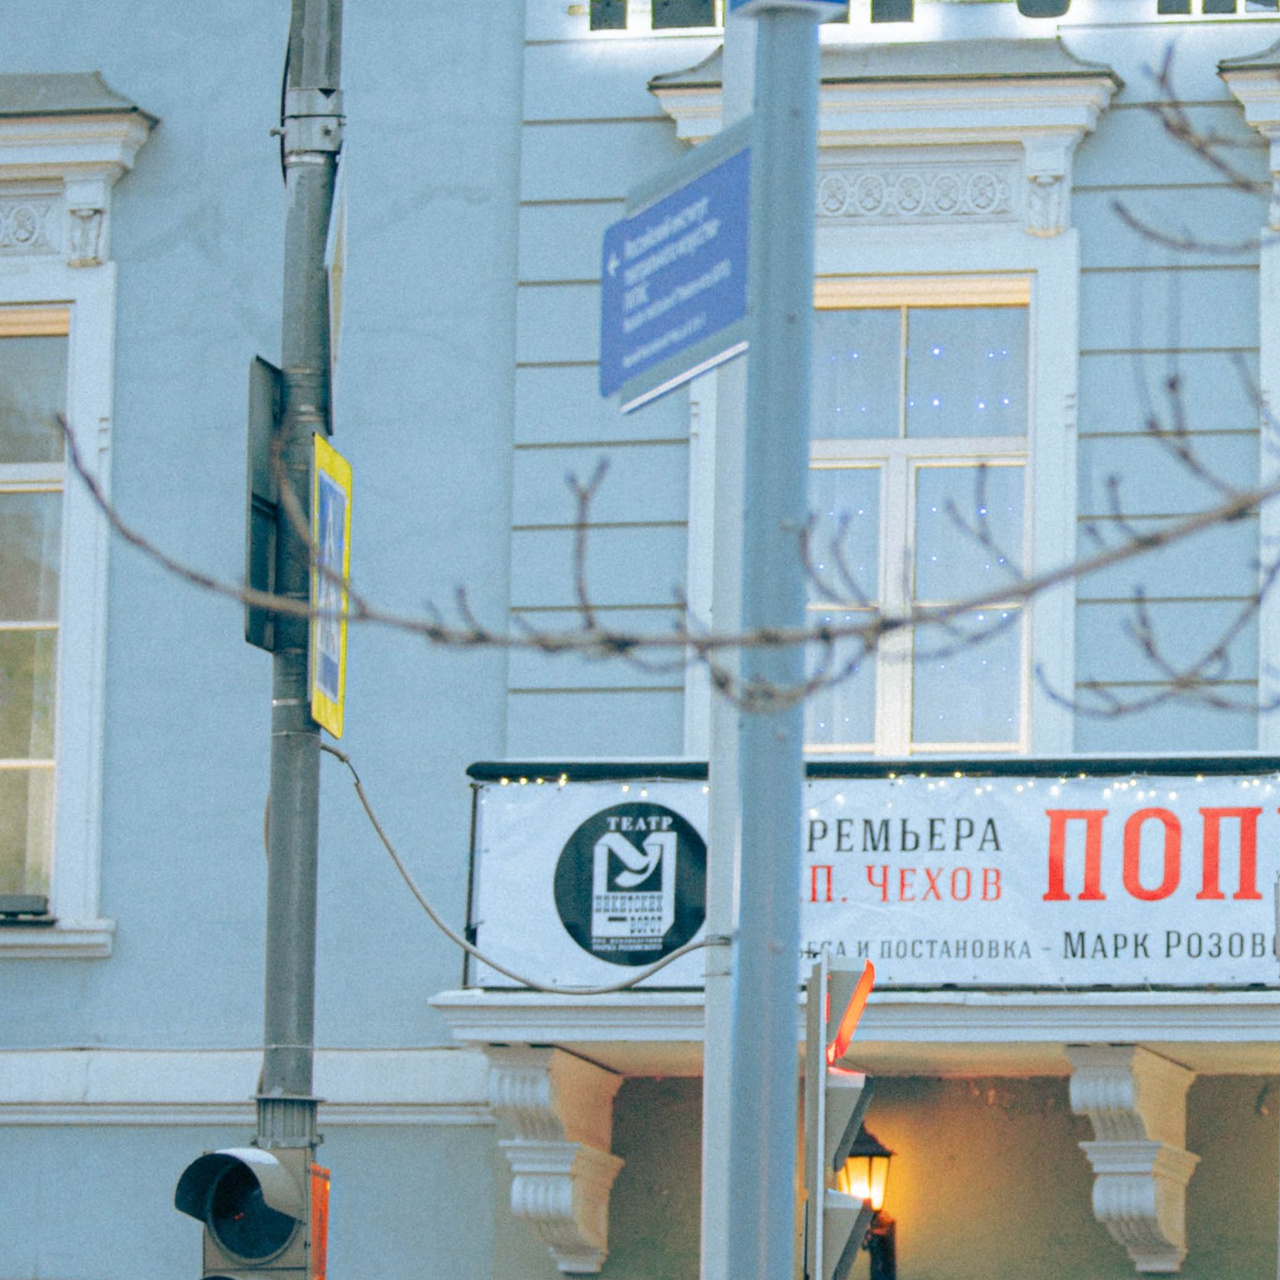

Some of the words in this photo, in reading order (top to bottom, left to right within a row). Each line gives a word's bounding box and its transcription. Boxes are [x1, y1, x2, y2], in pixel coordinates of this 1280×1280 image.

[607, 816, 673, 831] ТЕАТР
[807, 817, 1002, 852] РЕМЬЕРА
[865, 864, 1002, 903] ЧЕХОВ
[857, 940, 869, 958] И
[880, 939, 1032, 959] ПОСТАНОВКА
[1062, 930, 1151, 959] МАРК
